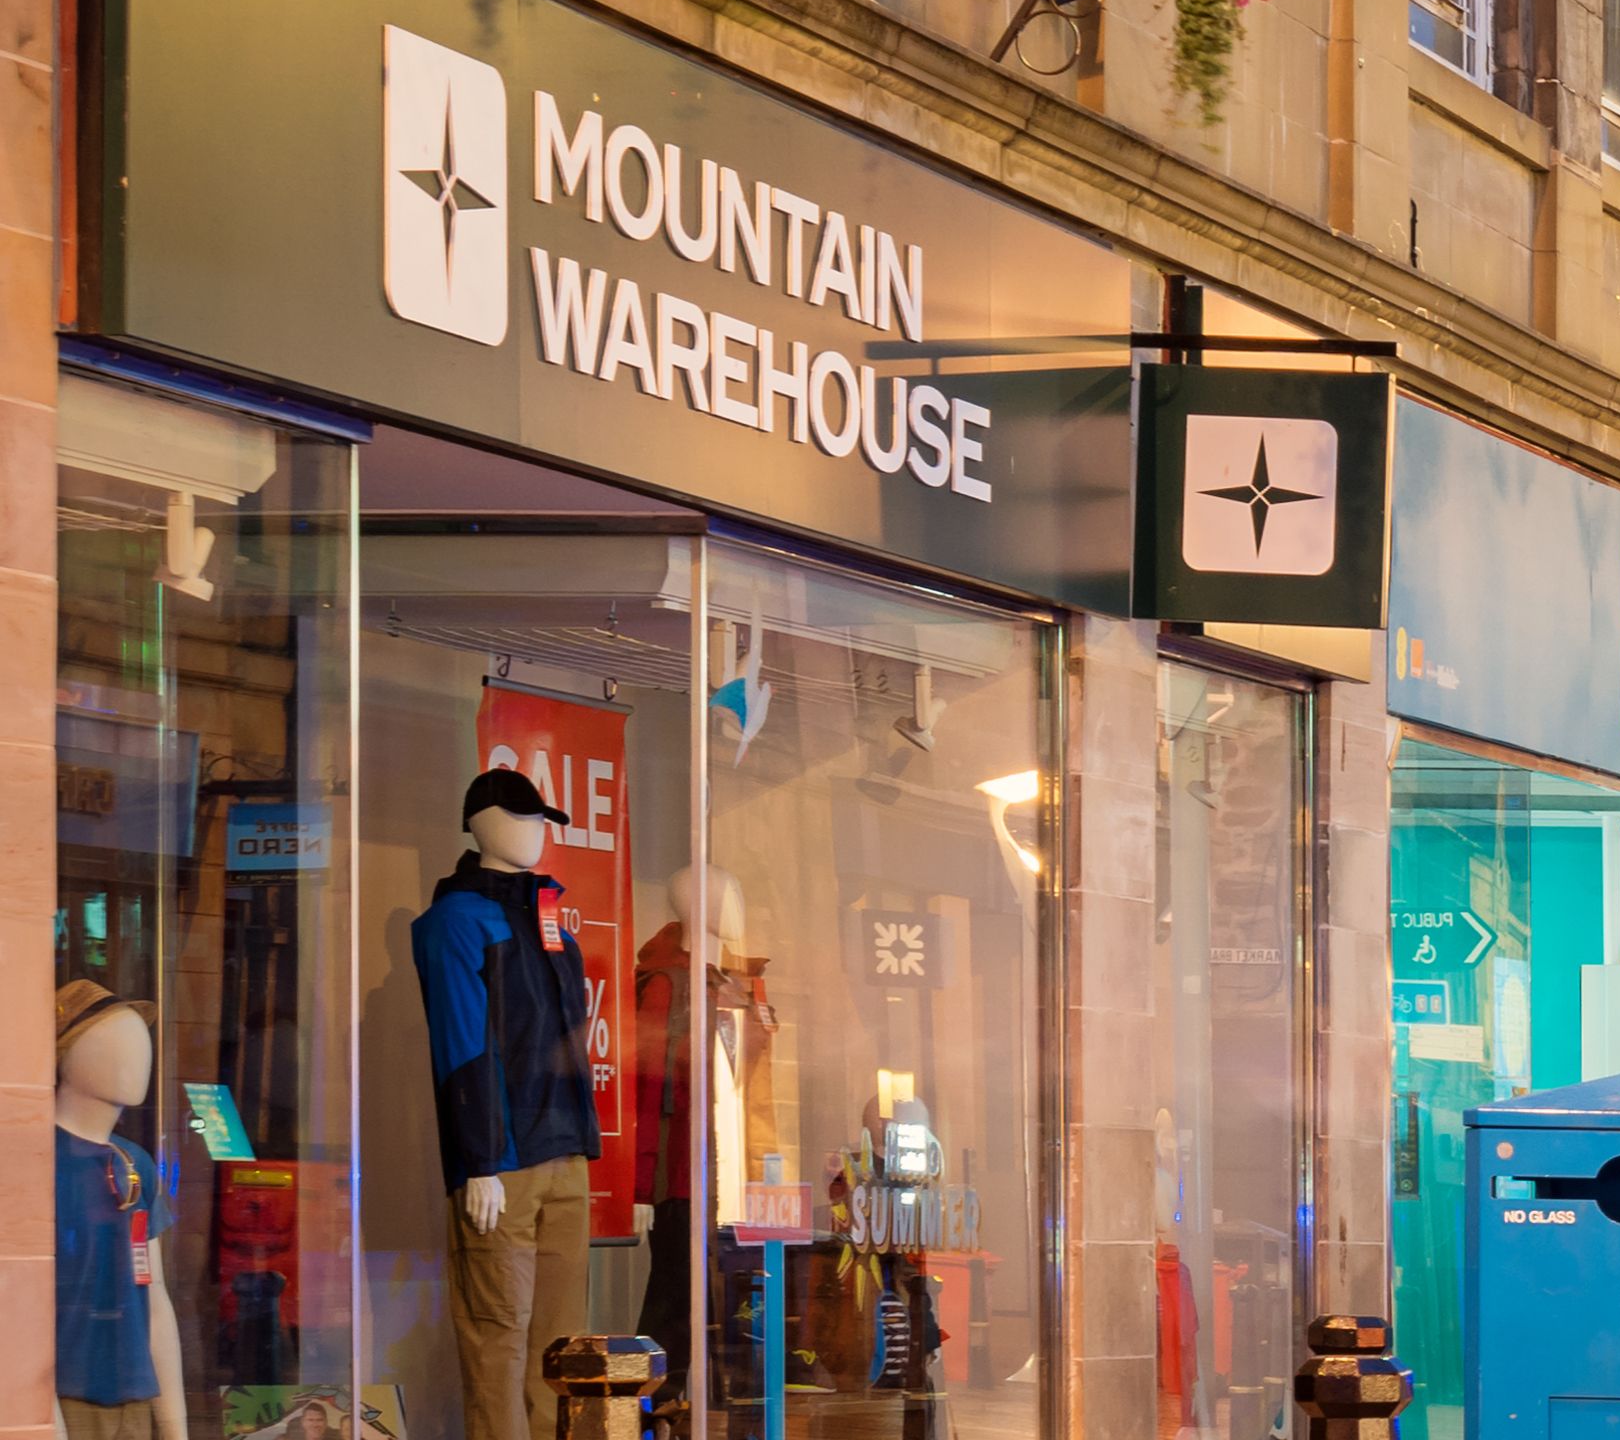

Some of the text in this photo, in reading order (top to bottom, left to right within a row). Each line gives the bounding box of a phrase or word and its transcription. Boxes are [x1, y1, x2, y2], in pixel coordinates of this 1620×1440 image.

[534, 90, 923, 343] MOUNTAIN
[531, 246, 991, 504] WAREHOUSE
[851, 1185, 981, 1250] SUMMER
[1503, 1210, 1576, 1224] NO GLASS
